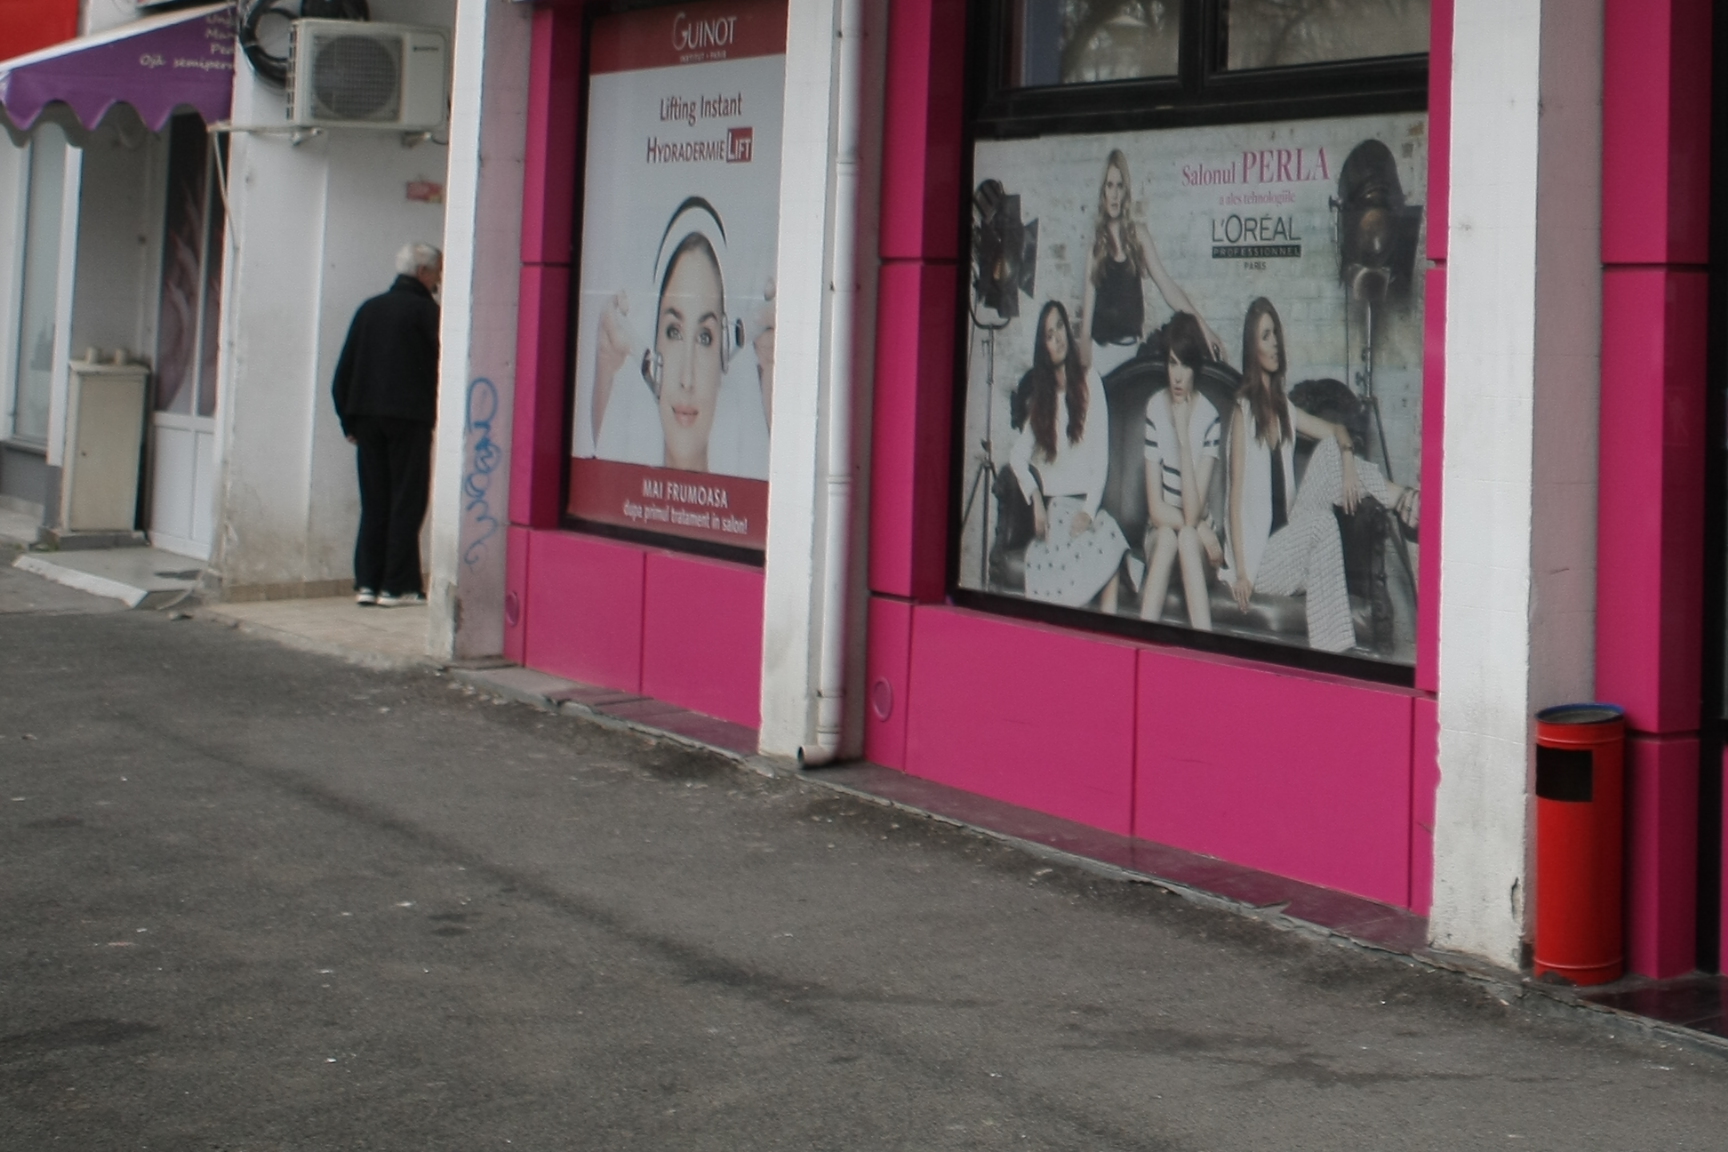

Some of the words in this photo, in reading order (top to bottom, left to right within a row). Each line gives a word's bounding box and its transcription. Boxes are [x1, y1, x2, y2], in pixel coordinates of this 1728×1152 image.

[660, 96, 696, 127] Lifting
[701, 92, 742, 118] Instant
[1182, 162, 1236, 187] Salonul
[1242, 147, 1330, 184] PERLA
[1213, 247, 1300, 258] PROFESSIONNEL
[1244, 261, 1266, 270] PARIS
[643, 479, 663, 498] MAI
[667, 481, 728, 509] FRUMOASA
